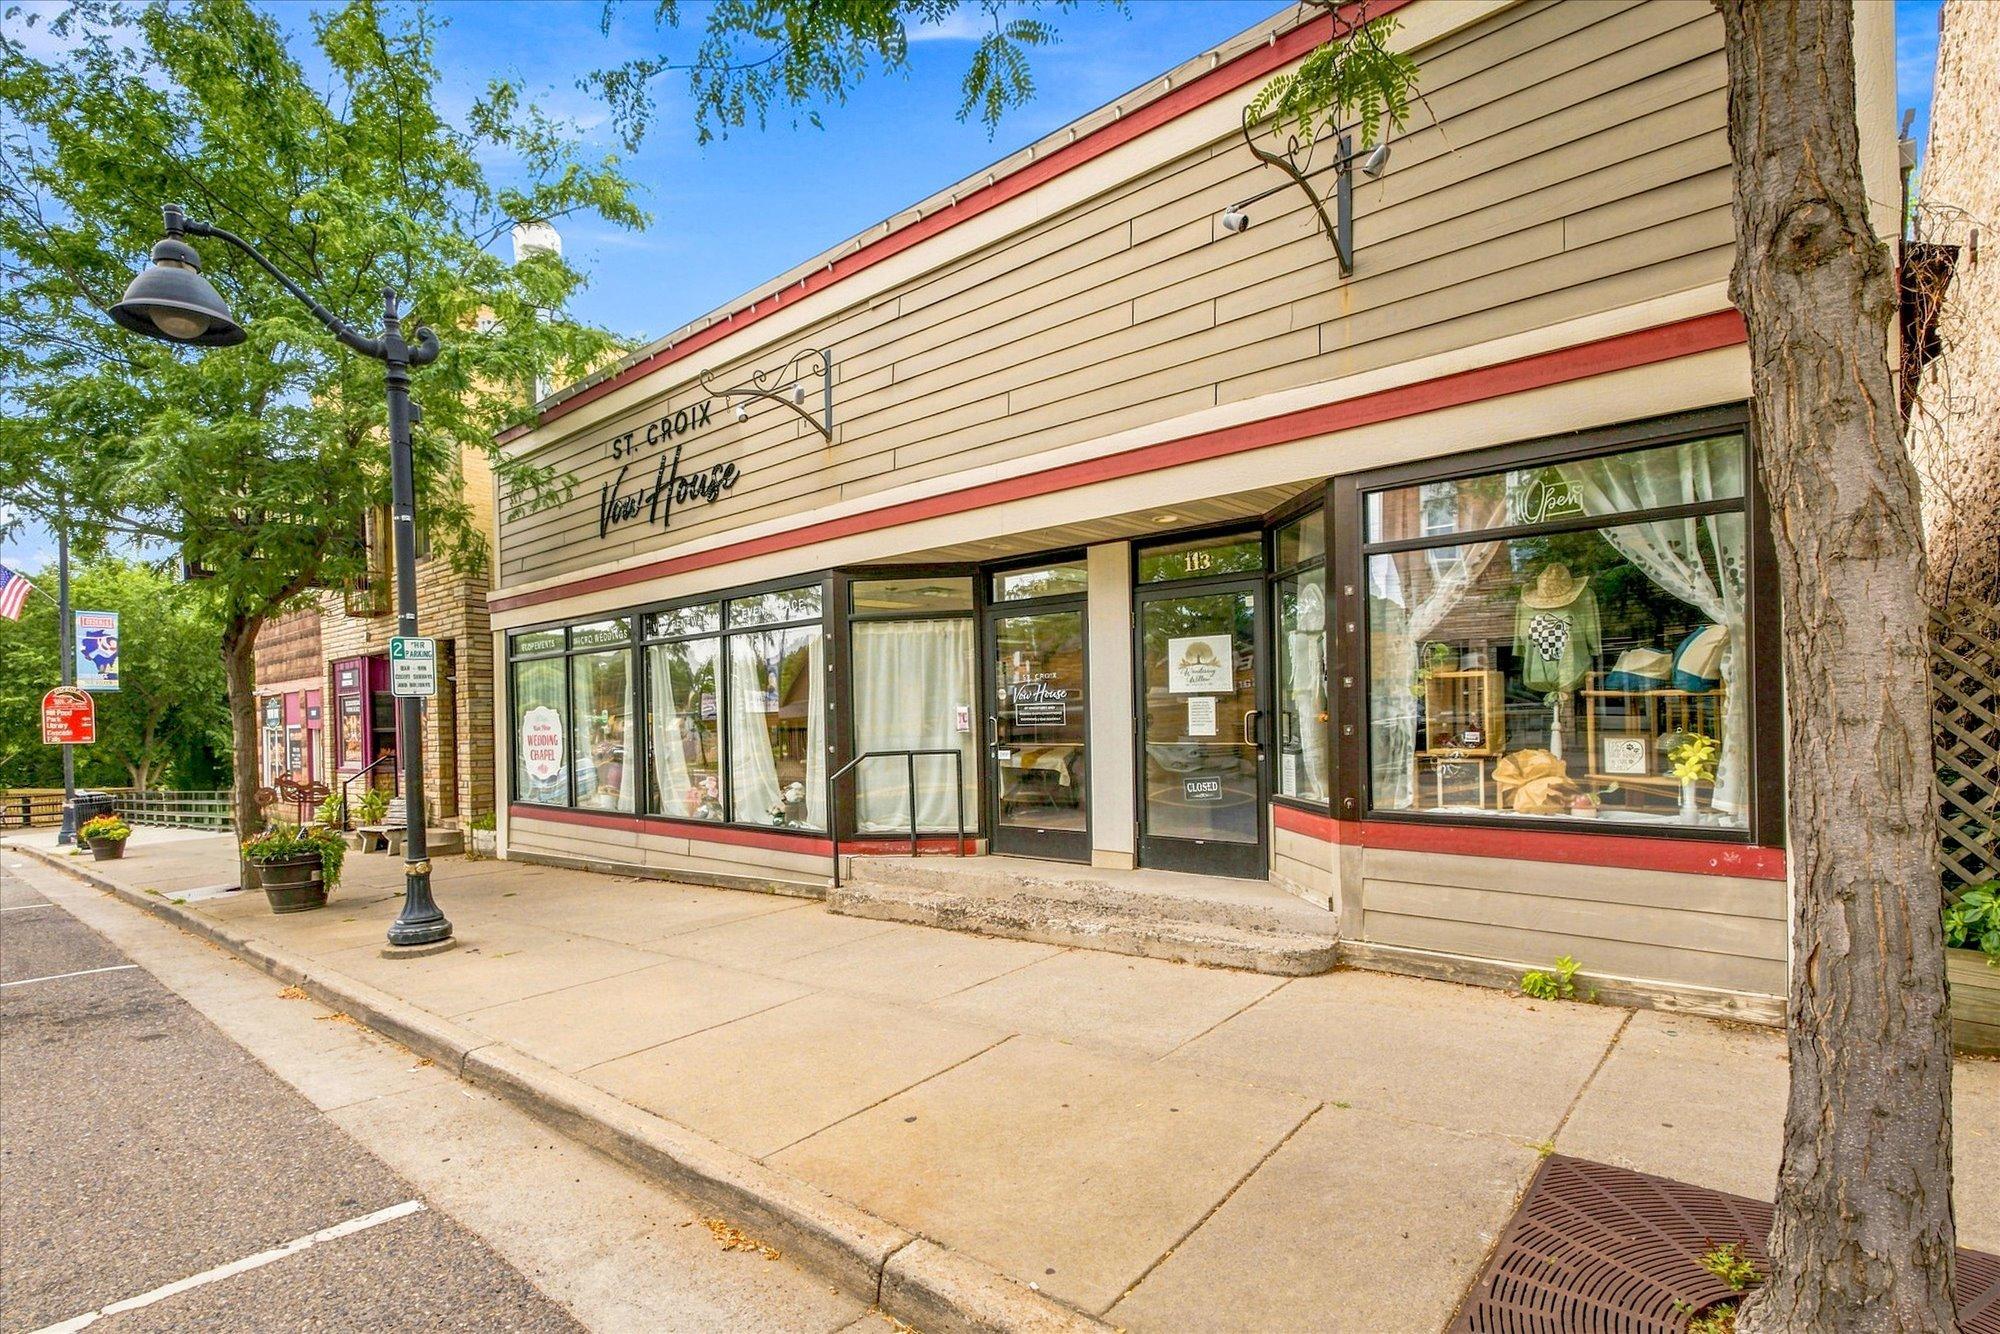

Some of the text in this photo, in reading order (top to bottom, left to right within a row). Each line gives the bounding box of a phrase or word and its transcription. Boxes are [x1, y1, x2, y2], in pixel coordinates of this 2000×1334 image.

[612, 400, 712, 460] ST. CROIX
[600, 444, 741, 540] Vow House
[1520, 480, 1579, 524] Open
[1184, 550, 1212, 572] 113
[521, 639, 555, 652] ELOPEMENTS
[573, 629, 629, 646] MICRO WEDDINGS
[393, 641, 403, 657] 2
[405, 650, 433, 658] PARKING
[1013, 682, 1068, 703] Vow House
[527, 734, 558, 747] WEDDING
[530, 749, 556, 761] CHAPEL
[1187, 781, 1218, 792] CLOSED
